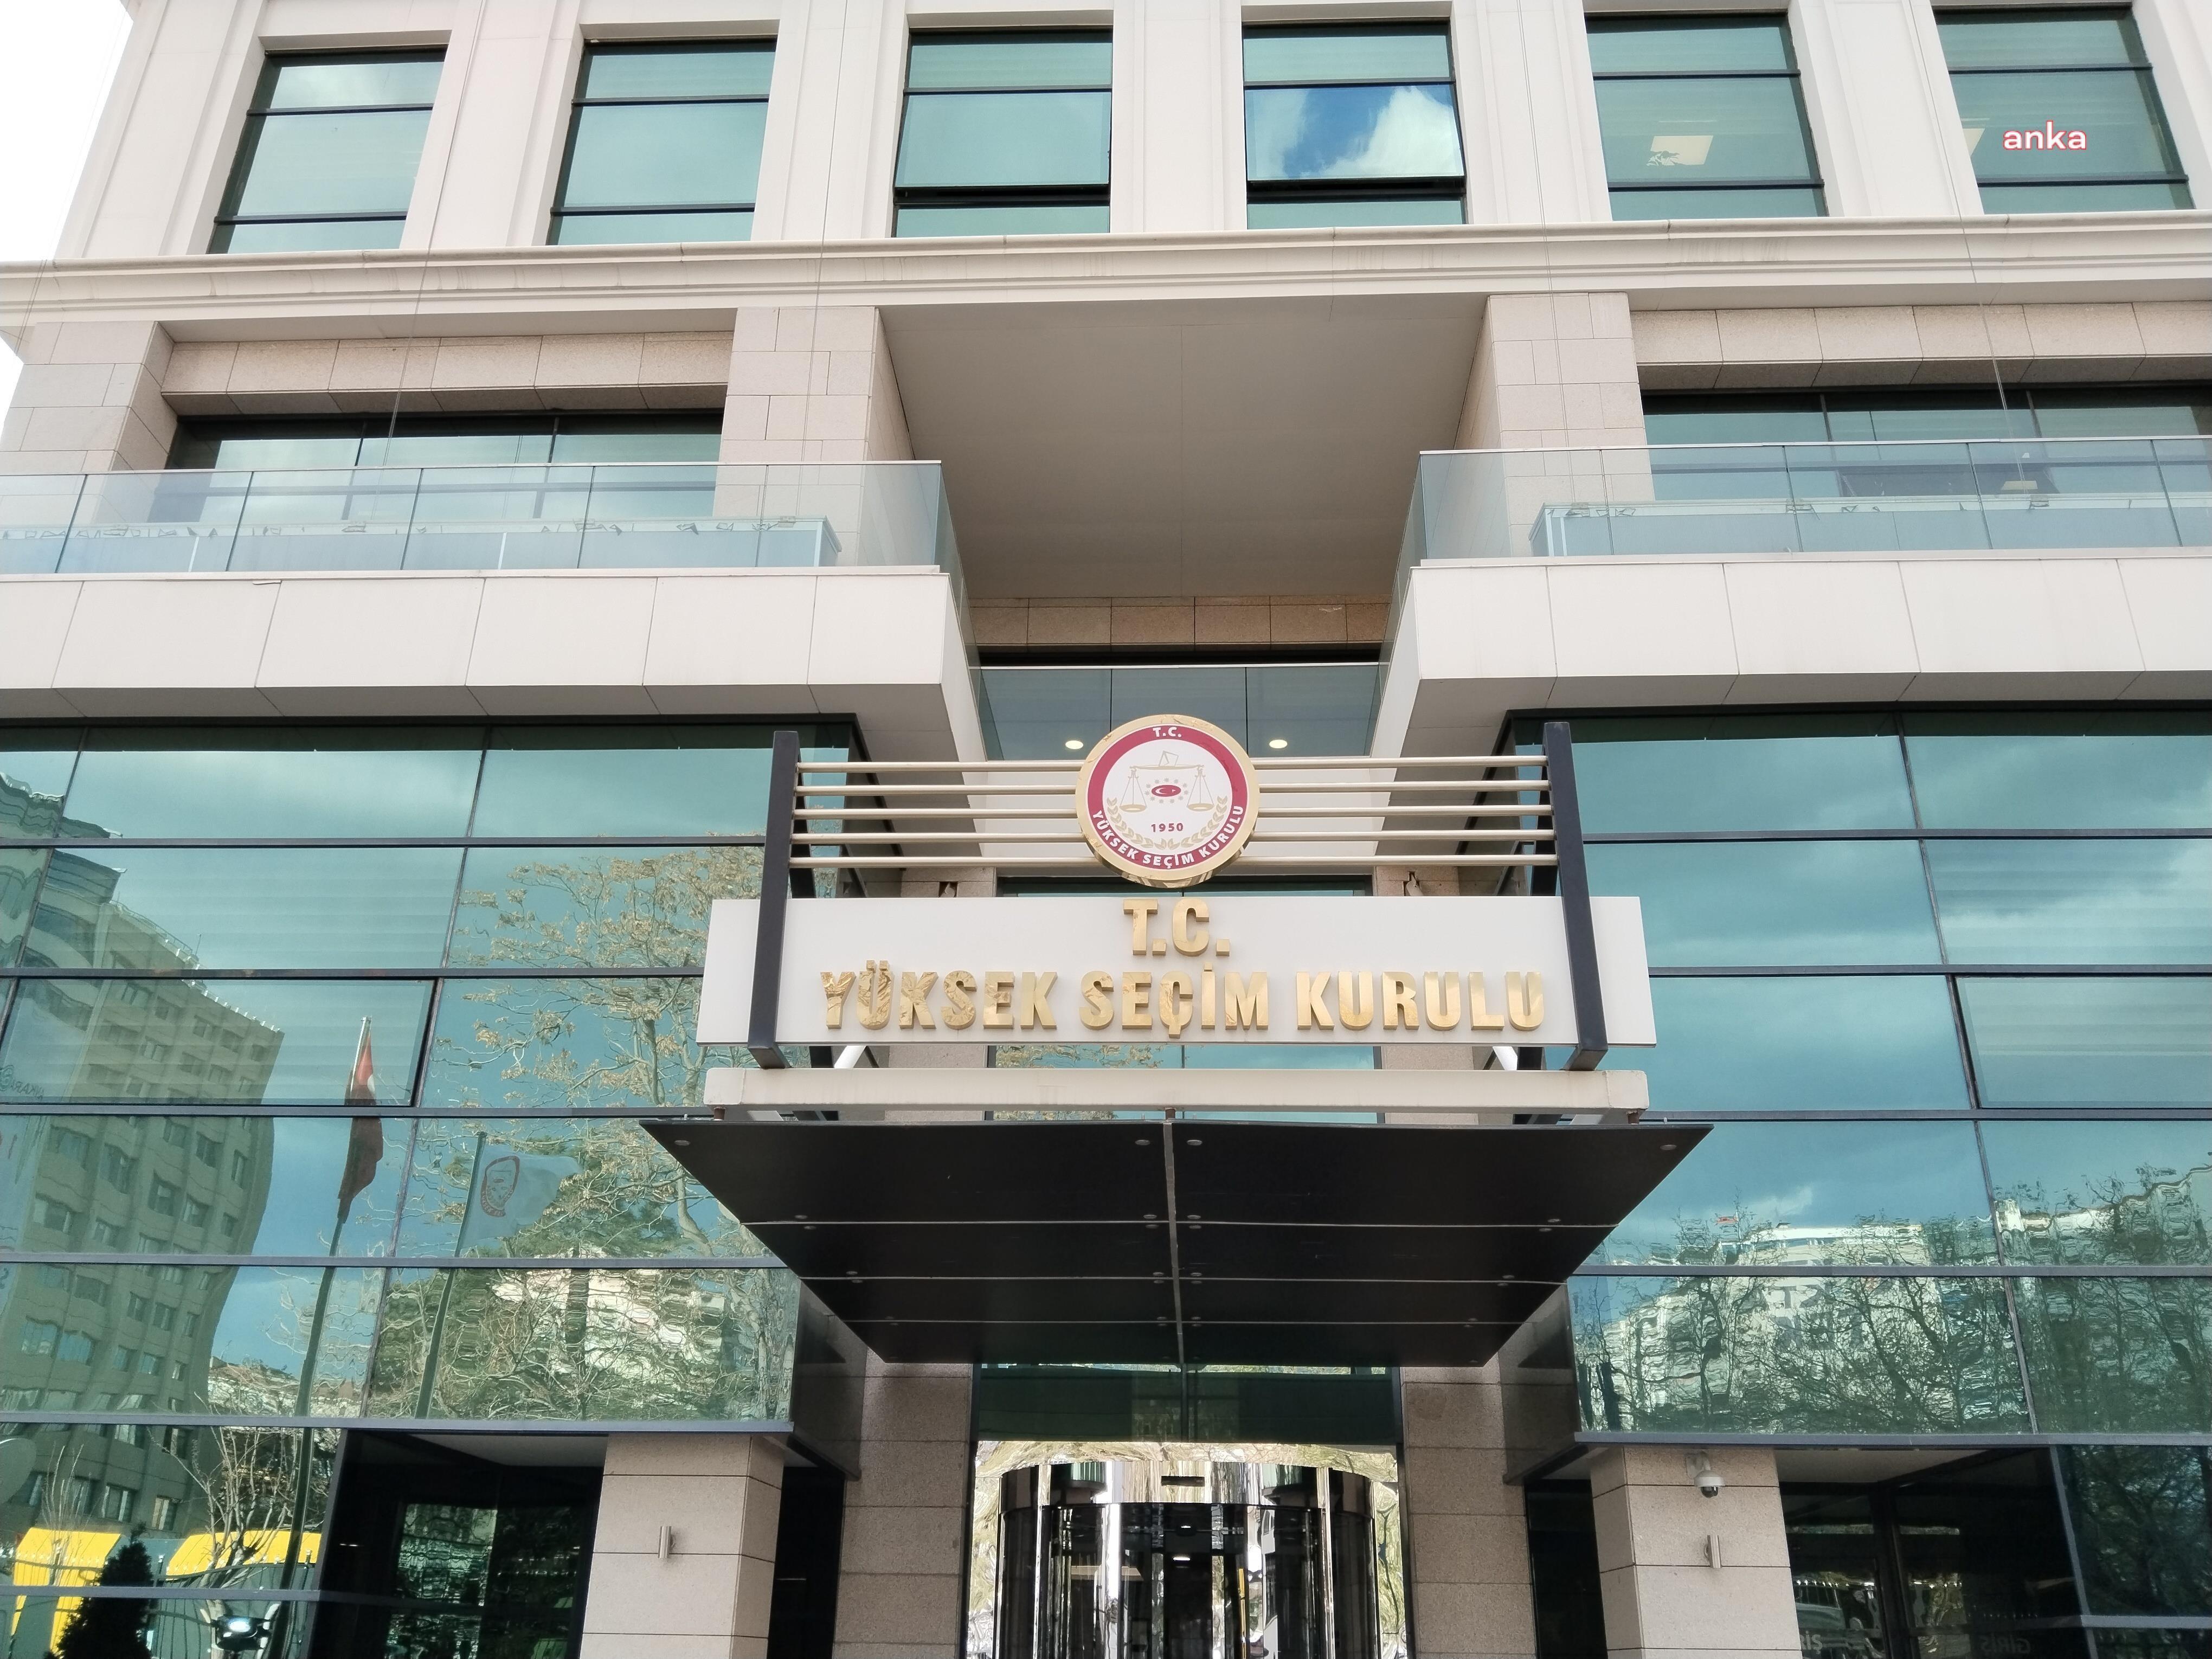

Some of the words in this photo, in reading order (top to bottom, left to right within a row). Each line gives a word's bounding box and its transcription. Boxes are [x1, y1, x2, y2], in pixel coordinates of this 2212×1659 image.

[1153, 727, 1182, 737] T.C.
[1092, 810, 1139, 860] YÜKSEK
[1142, 854, 1194, 869] SEÇİM
[1198, 806, 1244, 858] KURULU
[1151, 822, 1184, 832] 1950
[1123, 898, 1230, 956] T.C.
[820, 960, 1058, 1031] YÜKSEK
[1079, 962, 1269, 1038] SEÇİM
[1296, 971, 1545, 1031] KURULU
